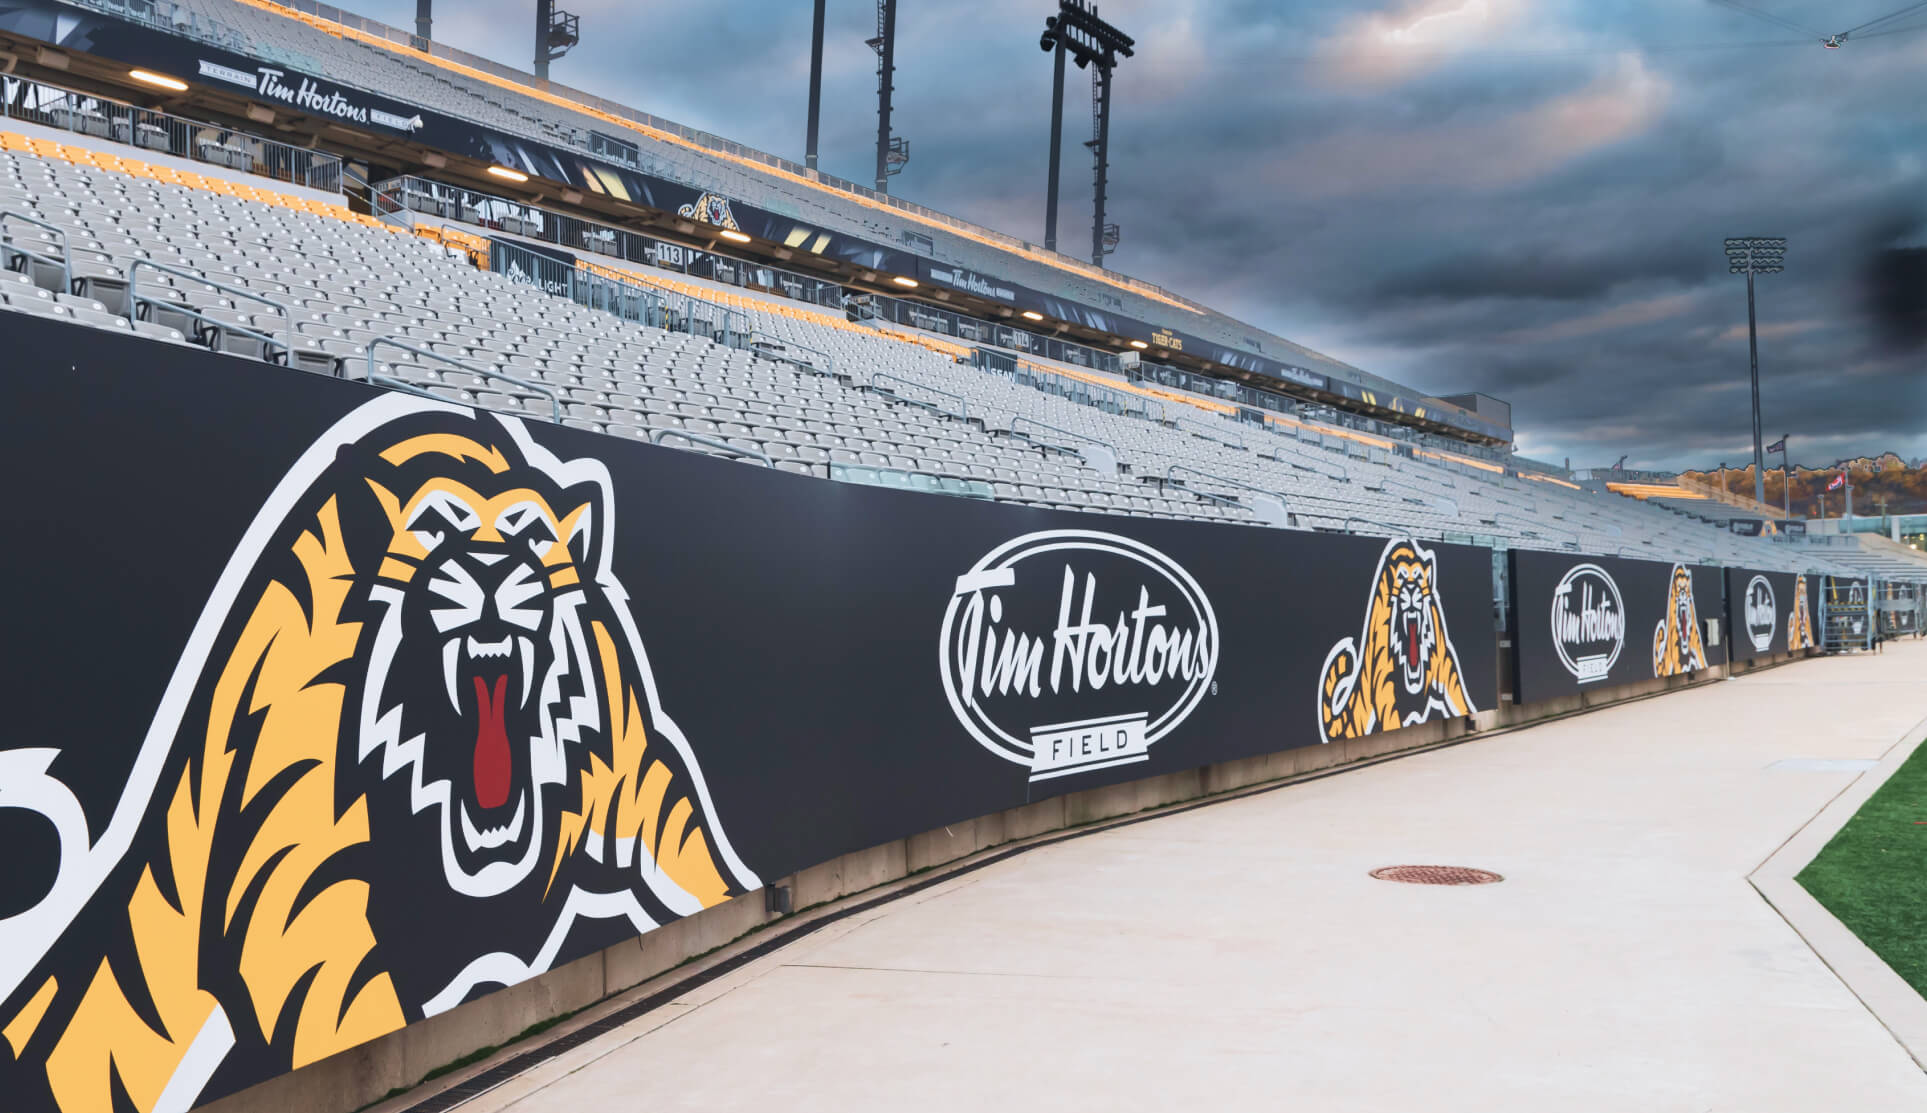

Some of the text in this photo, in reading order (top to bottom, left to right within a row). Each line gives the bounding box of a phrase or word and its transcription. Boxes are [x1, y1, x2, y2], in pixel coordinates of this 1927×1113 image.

[257, 67, 294, 104] Tim
[296, 77, 367, 122] Hortons
[660, 244, 680, 263] 113
[538, 277, 568, 296] LIGHT
[952, 269, 967, 290] Tim
[1555, 581, 1623, 645] Tim Hortons
[955, 564, 1208, 707] Tim Hortons
[1051, 729, 1129, 761] FIELD
